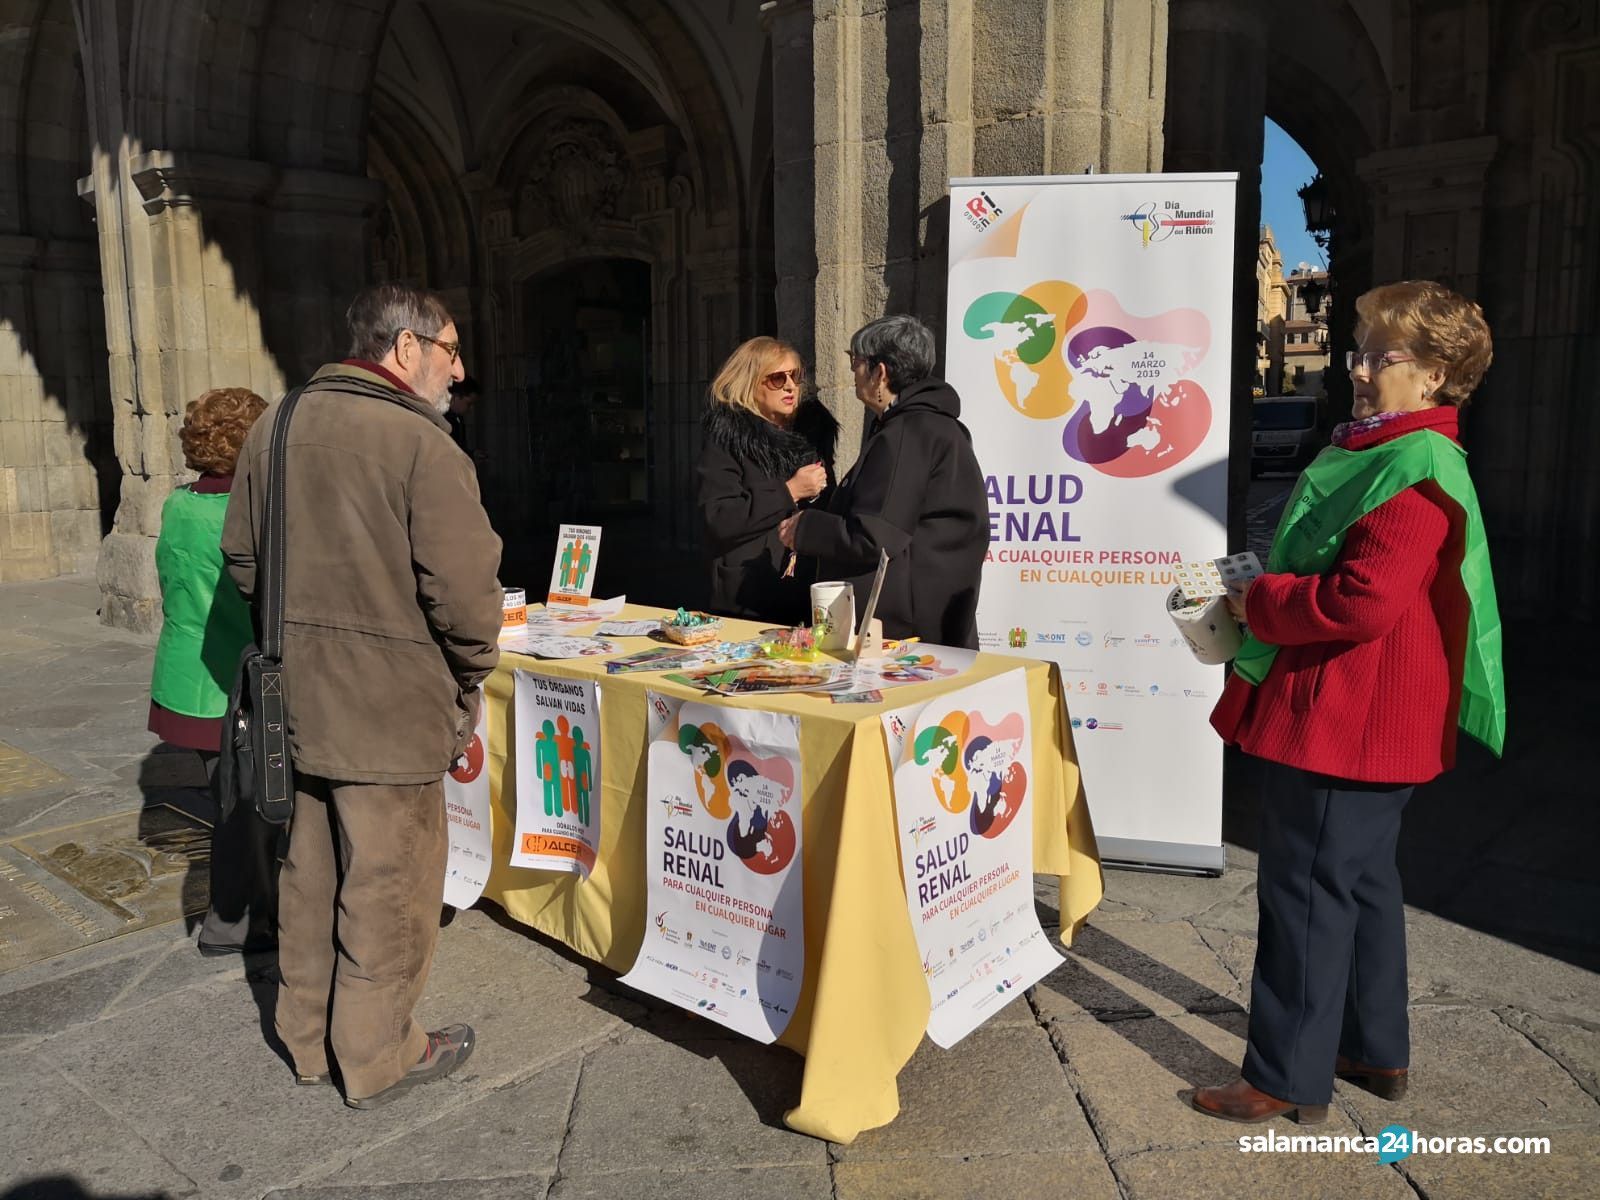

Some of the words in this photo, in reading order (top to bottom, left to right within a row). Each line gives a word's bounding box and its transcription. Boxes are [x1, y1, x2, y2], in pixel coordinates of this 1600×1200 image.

[1164, 201, 1180, 209] Día
[1175, 209, 1214, 218] Mundial
[1185, 225, 1213, 235] Riñón
[1131, 360, 1166, 369] MARZO
[1143, 351, 1155, 359] 14
[1136, 369, 1160, 378] 2019
[983, 473, 1084, 505] ALUD
[988, 511, 1082, 542] ENAL
[998, 550, 1094, 566] CUALQUIER
[1098, 551, 1182, 564] PERSONA
[1020, 569, 1041, 582] EN
[1046, 570, 1145, 587] CUALQUIER
[532, 678, 548, 690] TUS
[536, 694, 563, 710] SALVAN
[565, 701, 586, 715] VIDAS
[447, 802, 473, 817] PERSONA
[463, 815, 481, 831] LUGAR
[664, 826, 725, 861] SALUD
[915, 832, 969, 878] SALUD
[663, 851, 725, 888] RENAL
[918, 860, 972, 908] RENAL
[922, 907, 939, 924] PARA
[940, 882, 979, 911] CUALQUIER
[979, 862, 1010, 888] PERSONA
[663, 877, 684, 891] PARA
[685, 883, 735, 907] CUALQUIER
[732, 898, 774, 920] PERSONA
[949, 907, 960, 920] EN
[960, 883, 998, 913] CUALQUIER
[998, 870, 1020, 889] LUGAR
[695, 901, 707, 912] EN
[707, 905, 756, 929] CUALQUIER
[756, 920, 787, 940] LUGAR
